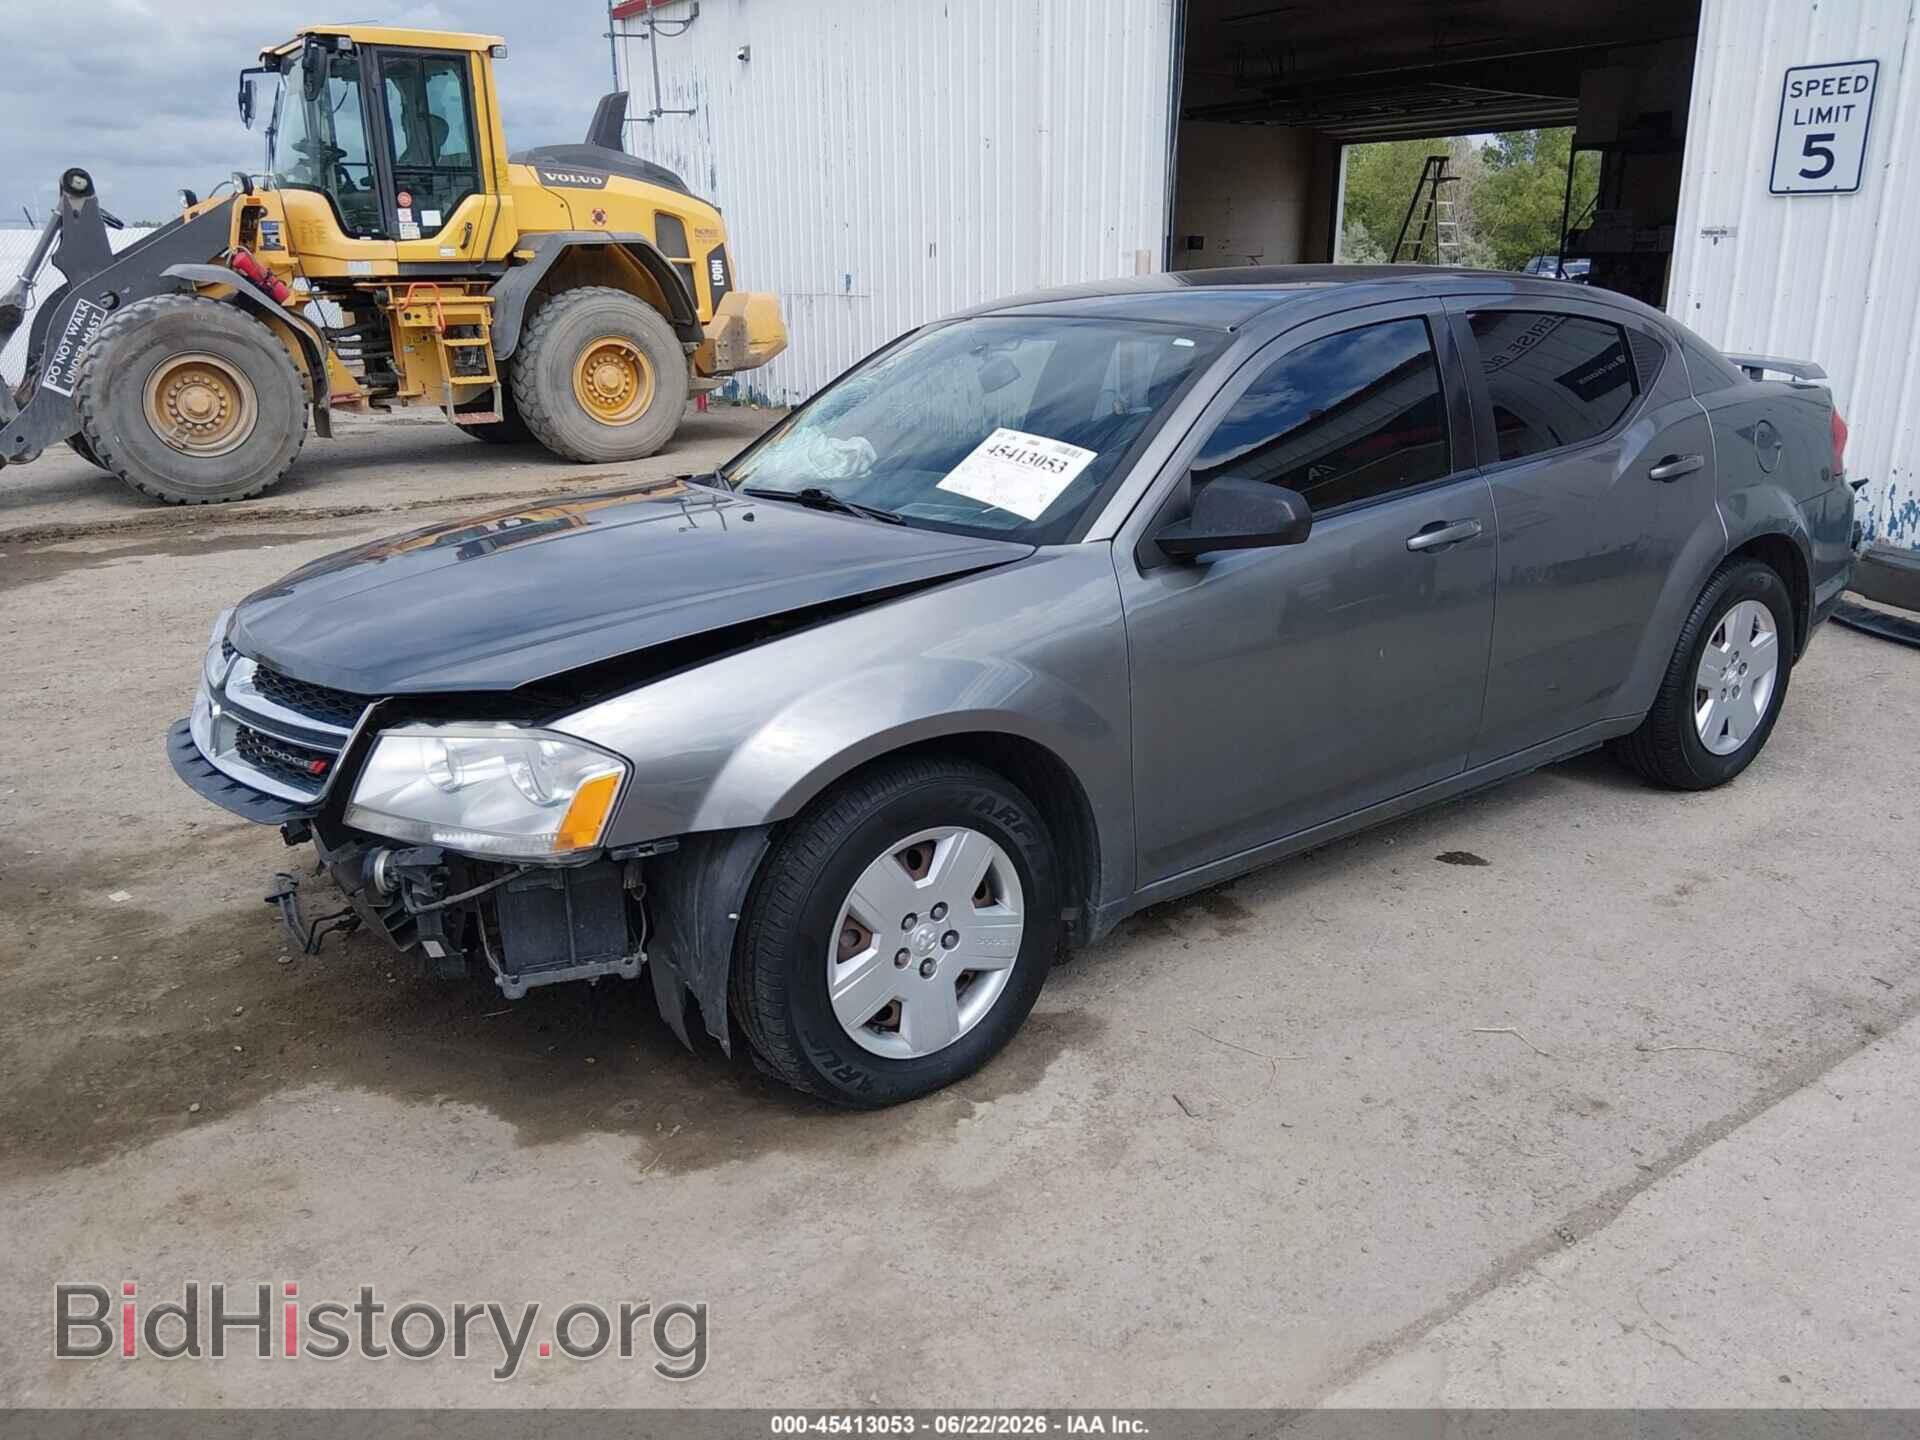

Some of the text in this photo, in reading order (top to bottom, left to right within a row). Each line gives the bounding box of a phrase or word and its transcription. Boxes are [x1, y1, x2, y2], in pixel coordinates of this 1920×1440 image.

[1790, 75, 1869, 98] SPEED
[1793, 104, 1856, 126] LIMIT
[1798, 133, 1836, 179] 5
[544, 172, 603, 185] VOLVO
[711, 259, 725, 286] L90H
[46, 302, 91, 385] DO NOT WALK
[63, 312, 102, 383] UNDER MAST
[987, 443, 1069, 474] 45413053
[262, 745, 311, 768] DODGE
